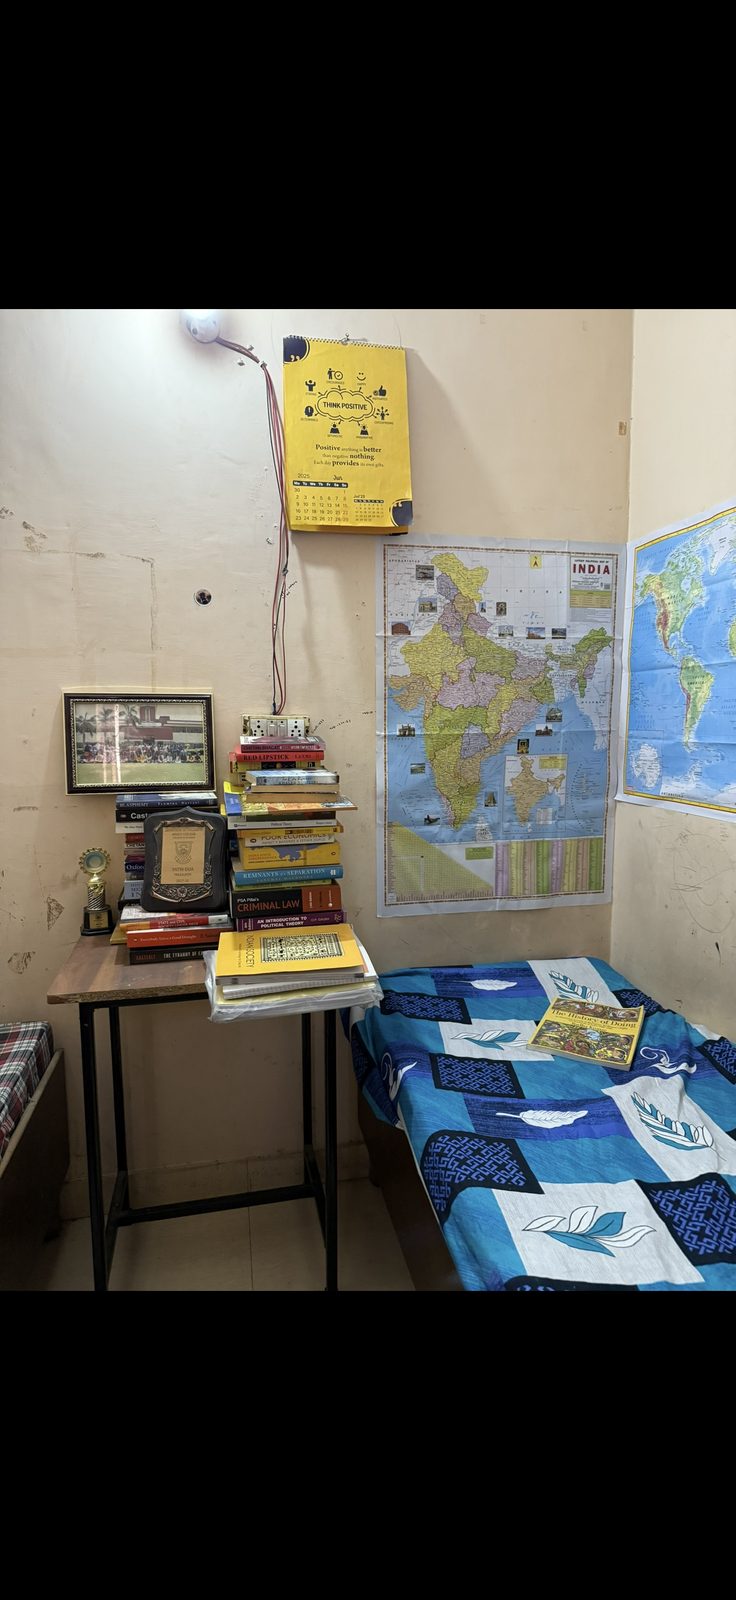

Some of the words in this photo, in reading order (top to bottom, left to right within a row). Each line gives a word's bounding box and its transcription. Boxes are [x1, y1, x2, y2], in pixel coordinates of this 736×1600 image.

[573, 564, 610, 574] INDIA
[237, 901, 280, 912] CRIMINAL
[282, 900, 300, 909] LAW
[246, 949, 255, 967] SOCIETY
[569, 1013, 597, 1022] History
